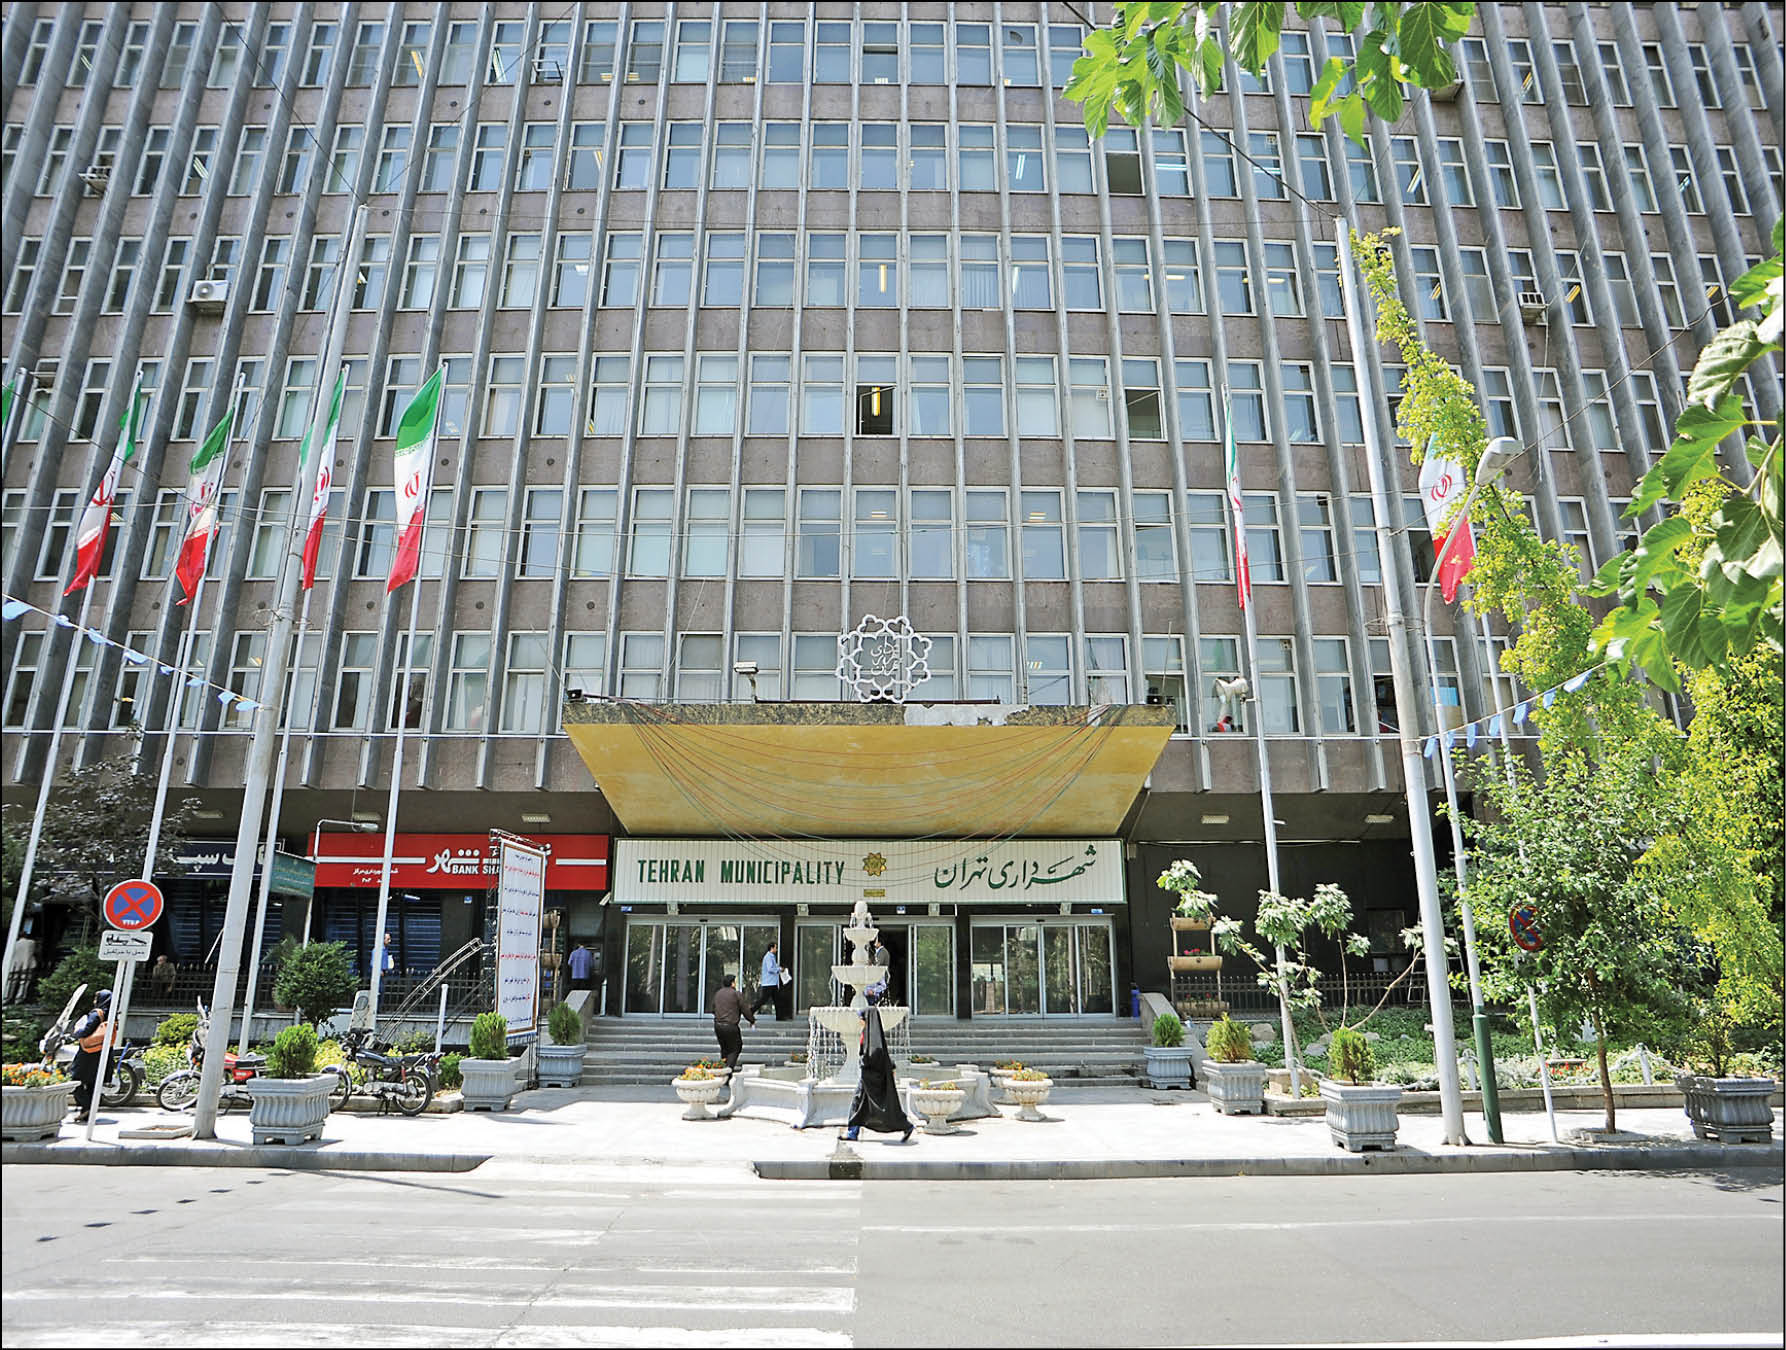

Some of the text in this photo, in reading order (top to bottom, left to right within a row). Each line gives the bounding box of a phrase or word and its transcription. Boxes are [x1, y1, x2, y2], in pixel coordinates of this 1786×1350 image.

[452, 864, 479, 875] BANK
[637, 859, 846, 886] TEHRAN MUNICIPALITY
[934, 844, 1097, 890] شهرداری تهران
